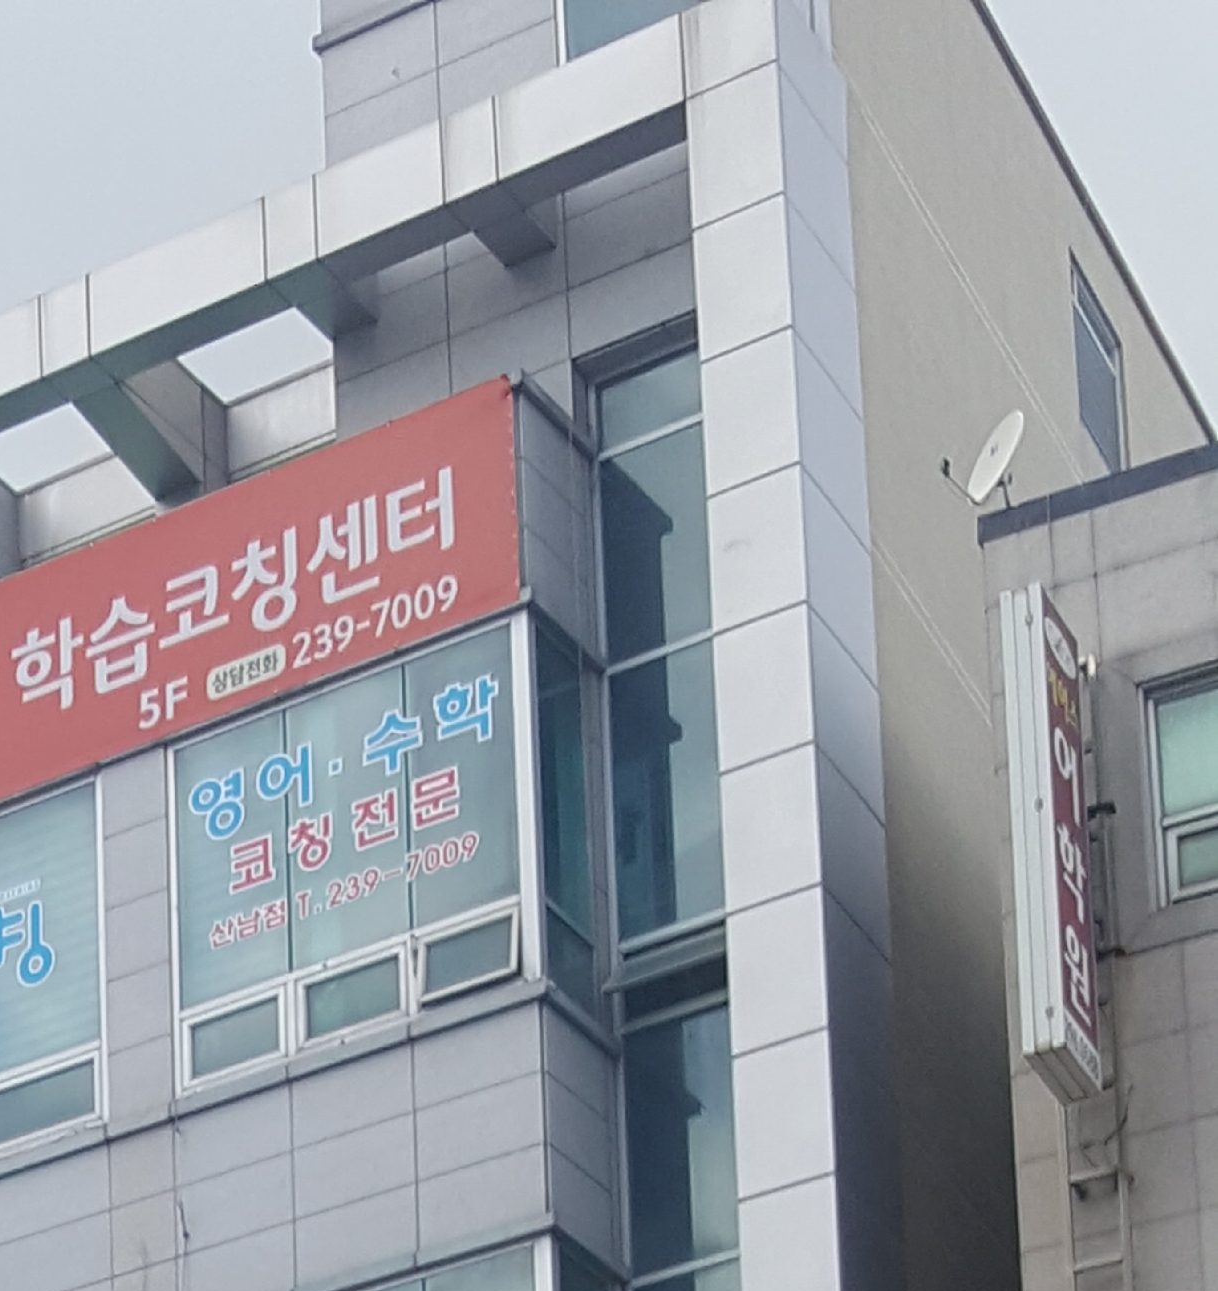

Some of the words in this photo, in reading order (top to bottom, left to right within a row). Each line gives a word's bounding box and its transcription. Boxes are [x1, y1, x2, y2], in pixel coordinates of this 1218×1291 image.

[11, 467, 456, 712] 학습코칭센터
[138, 677, 188, 730] 5F
[211, 647, 281, 695] 상담전화
[292, 576, 458, 670] 239-7009
[209, 901, 286, 951] 산남점
